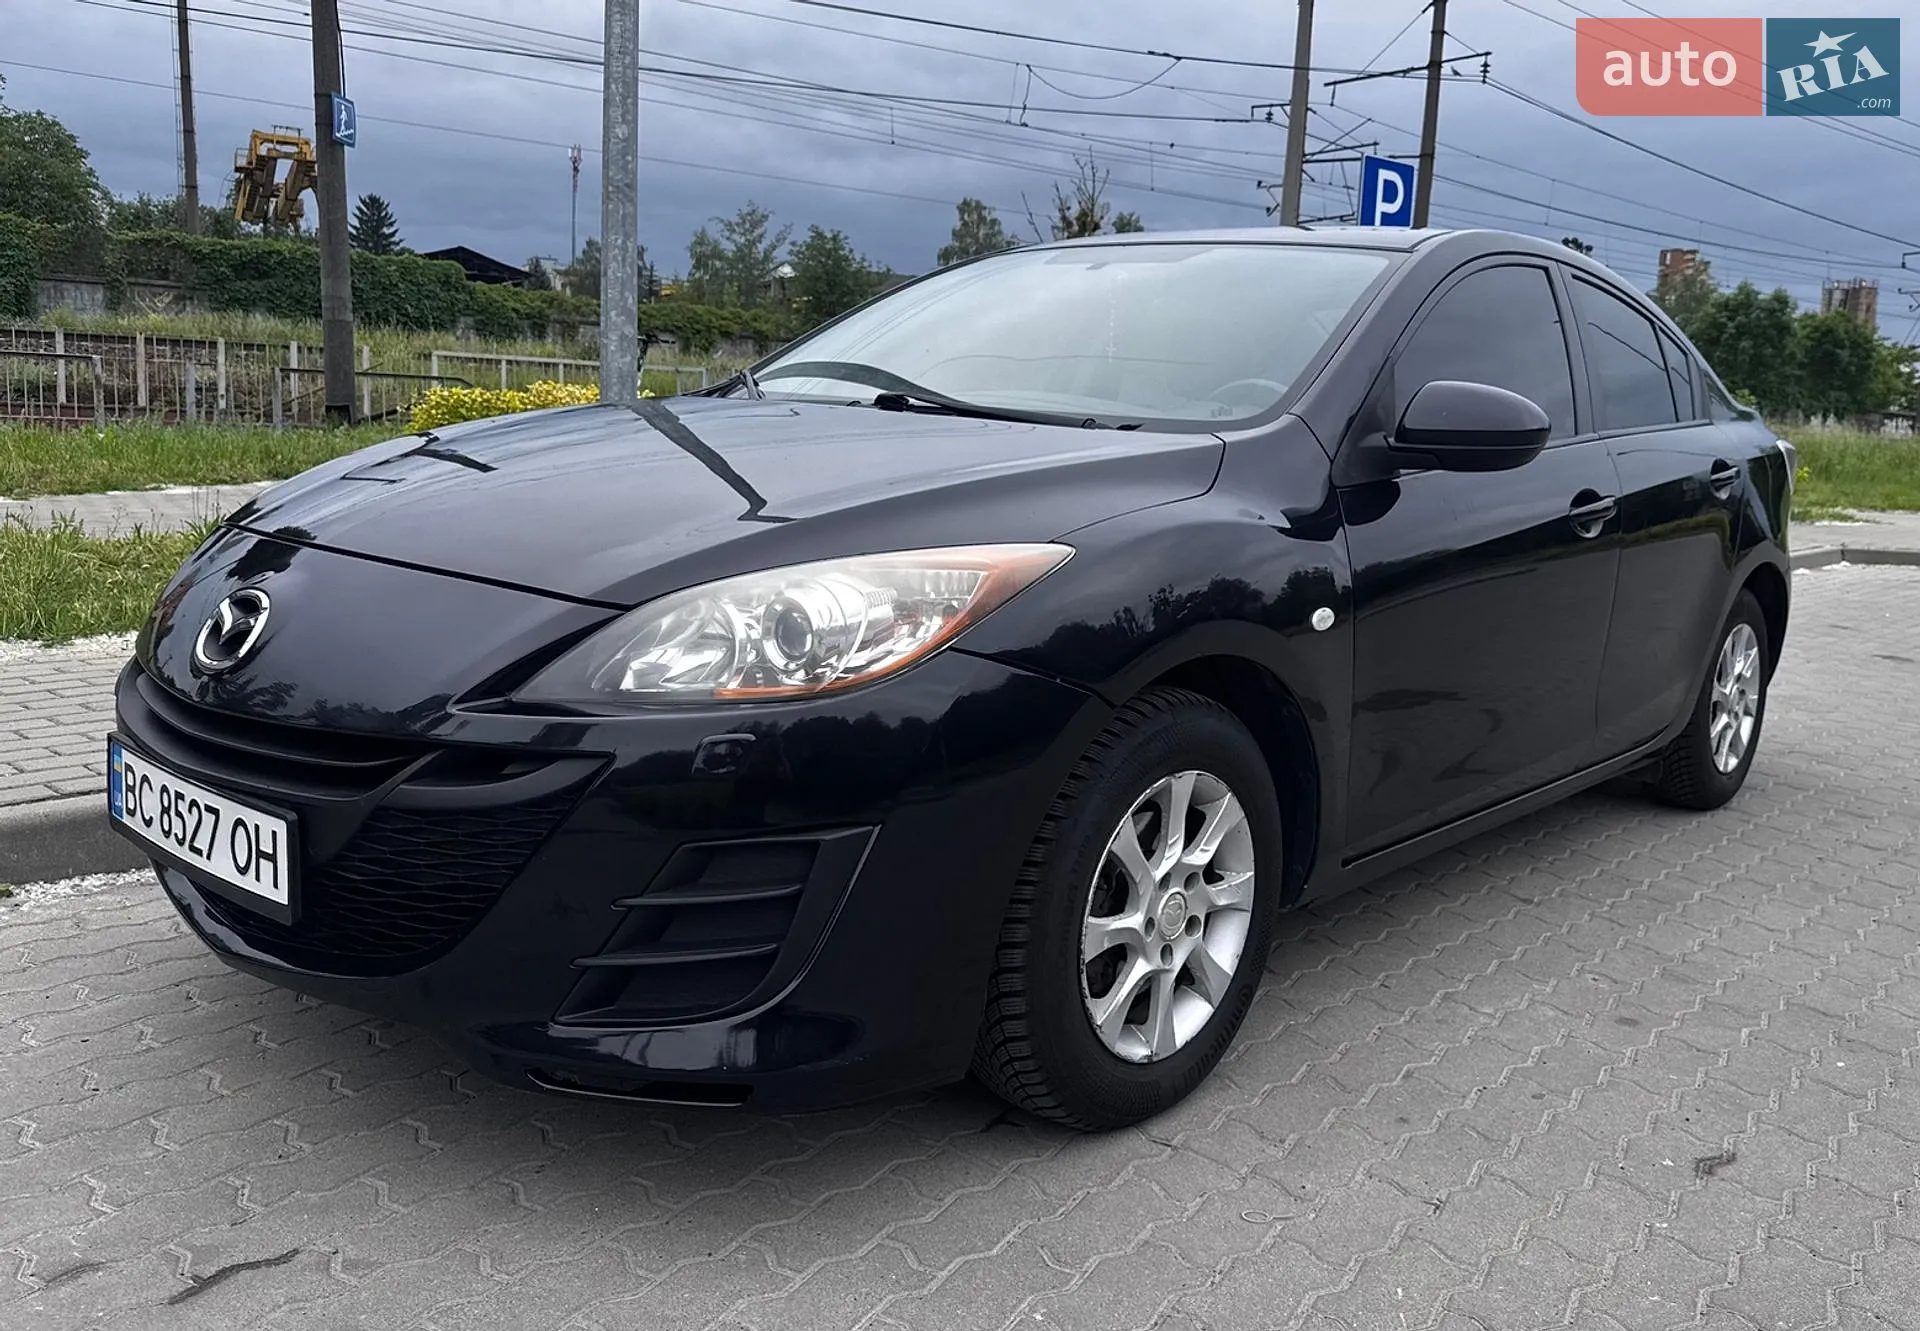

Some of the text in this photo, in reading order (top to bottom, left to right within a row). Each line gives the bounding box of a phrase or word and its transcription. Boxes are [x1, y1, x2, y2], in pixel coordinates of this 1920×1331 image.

[1374, 168, 1404, 227] P
[124, 761, 279, 890] BC 8527 OH
